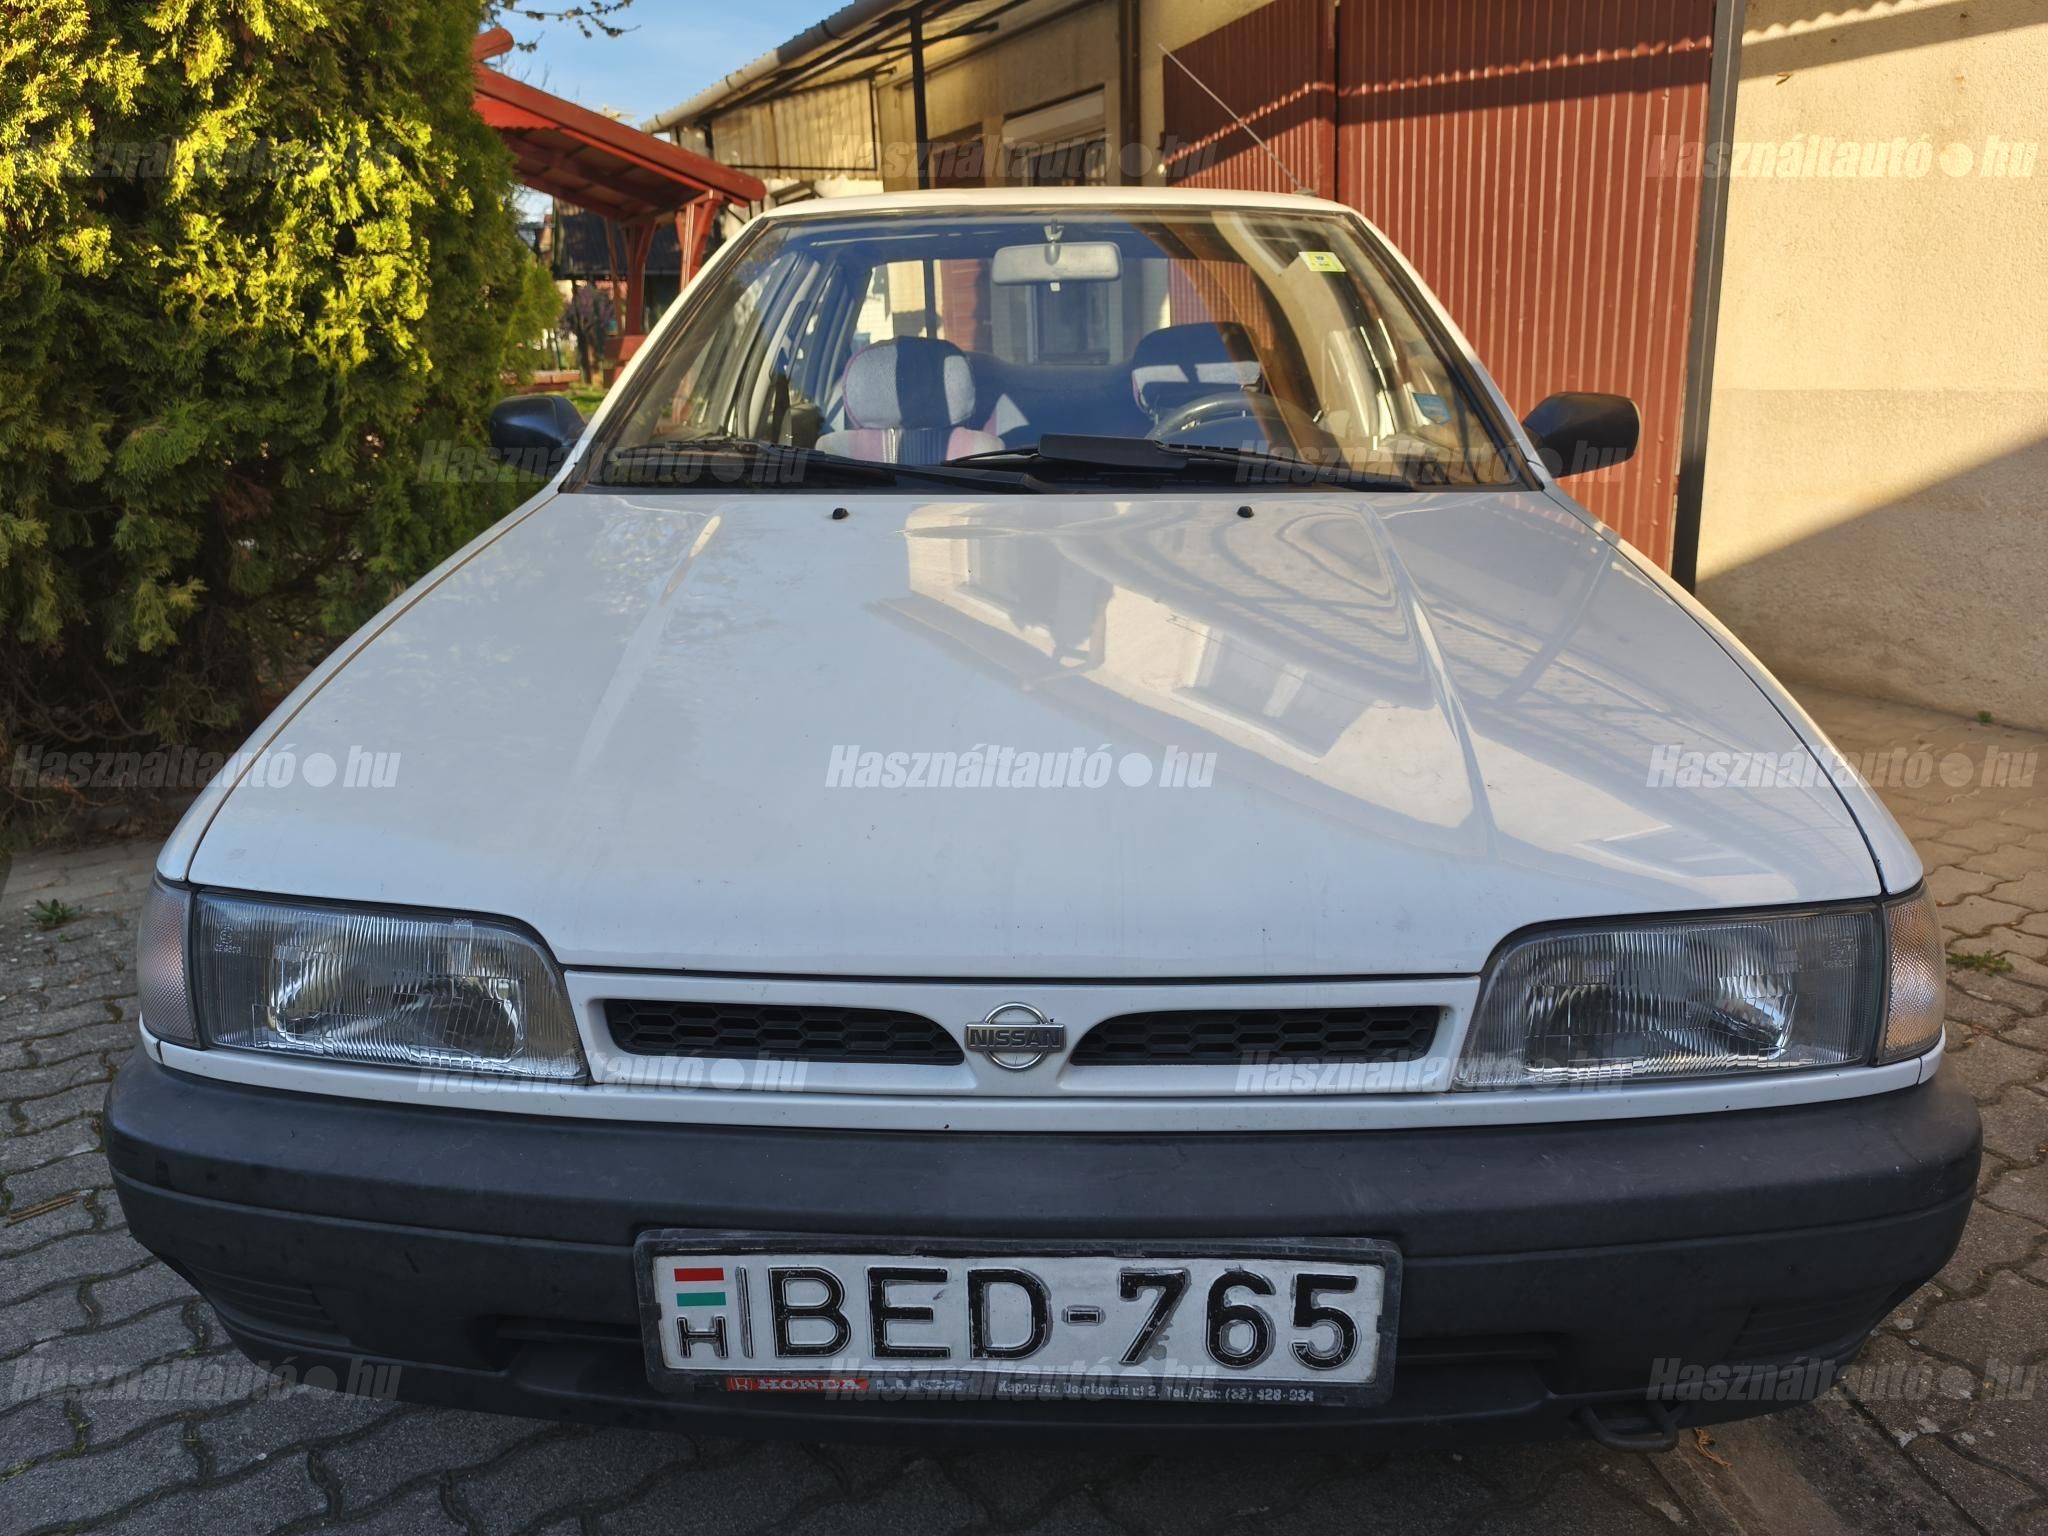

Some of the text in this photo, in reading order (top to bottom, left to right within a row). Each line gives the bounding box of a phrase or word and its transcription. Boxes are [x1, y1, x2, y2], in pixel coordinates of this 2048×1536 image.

[969, 1029, 1062, 1048] NISSAN
[767, 1265, 1361, 1369] BED-765
[677, 1315, 729, 1358] H
[758, 1378, 861, 1391] HONDA
